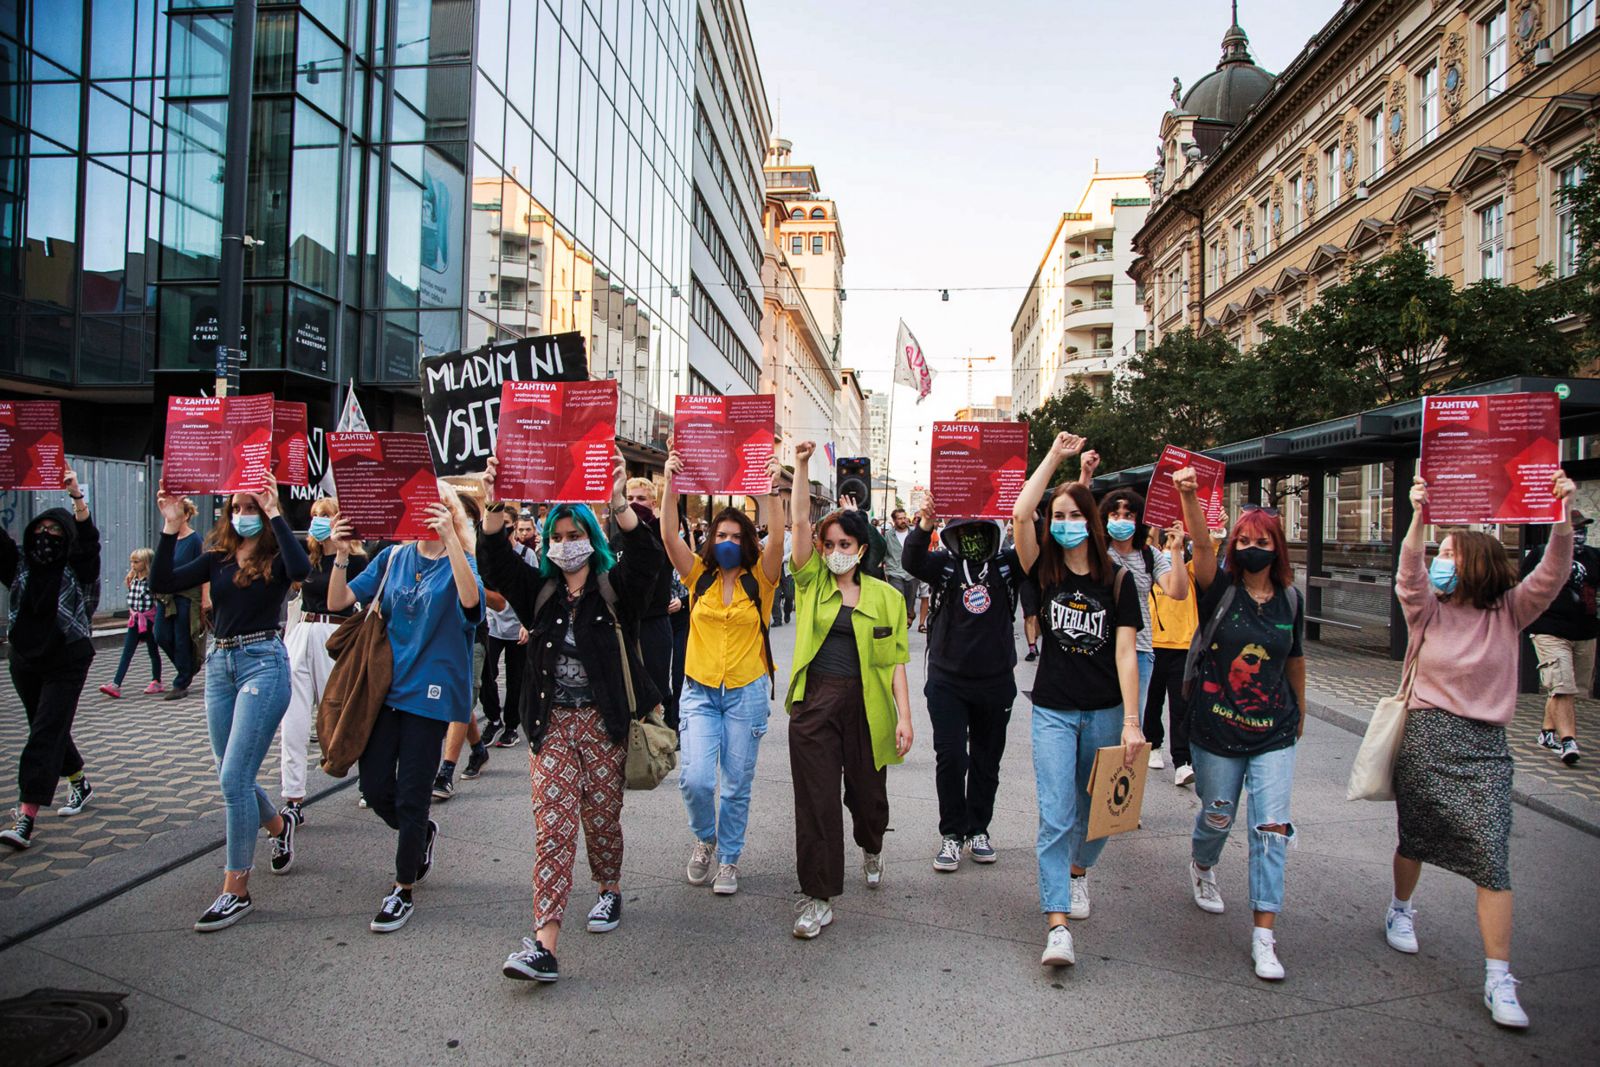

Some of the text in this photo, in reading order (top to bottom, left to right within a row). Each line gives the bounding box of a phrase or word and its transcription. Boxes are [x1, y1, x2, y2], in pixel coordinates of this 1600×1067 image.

[1276, 30, 1400, 157] POŠTA SLOVENIJE
[426, 346, 520, 394] MLADIM
[530, 336, 564, 380] NI
[290, 485, 324, 500] NAMA
[1051, 600, 1106, 640] EVERLAST
[1212, 703, 1233, 719] BOB
[1235, 714, 1274, 727] MARLEY
